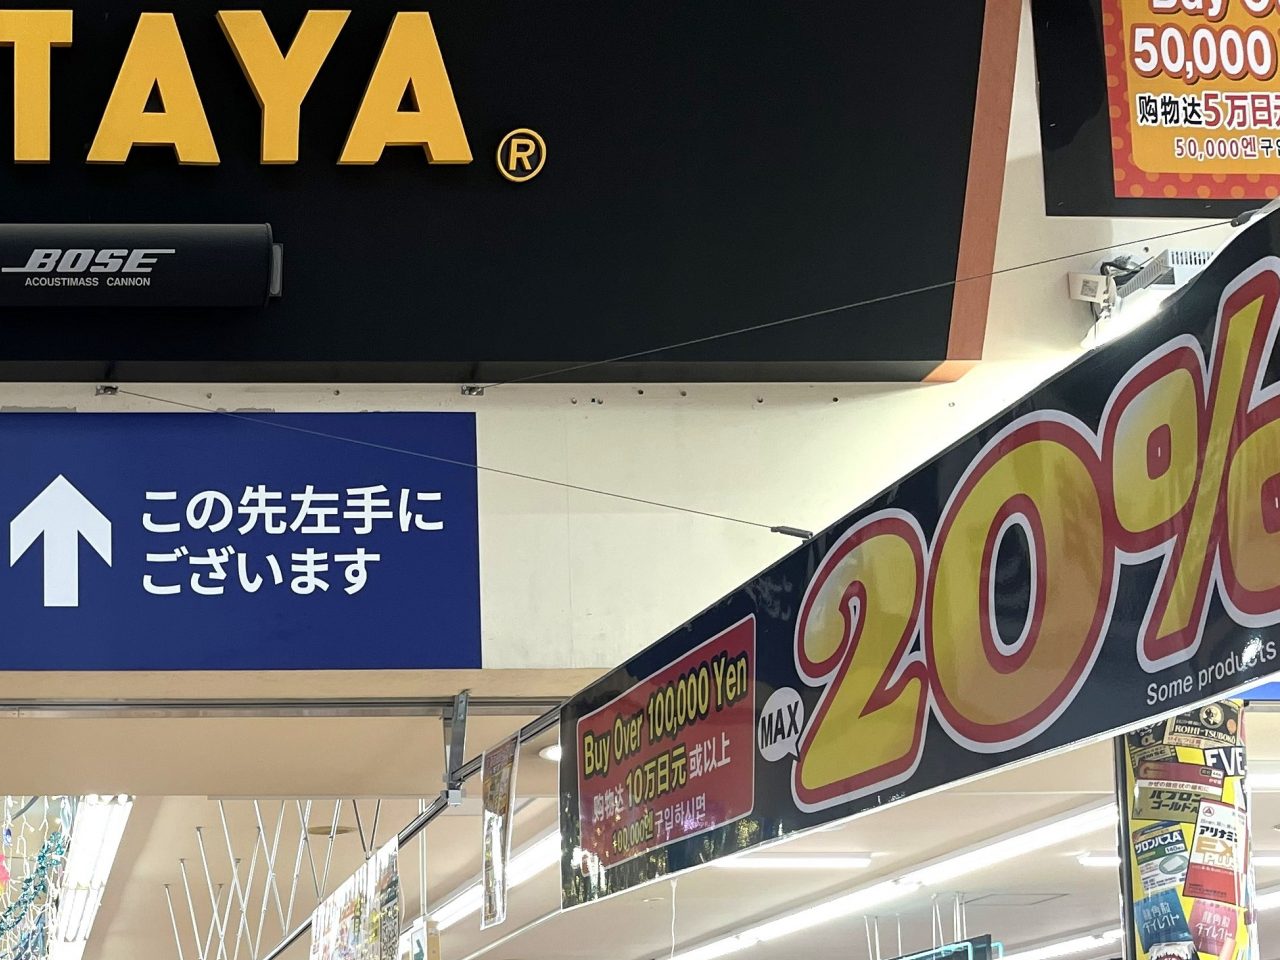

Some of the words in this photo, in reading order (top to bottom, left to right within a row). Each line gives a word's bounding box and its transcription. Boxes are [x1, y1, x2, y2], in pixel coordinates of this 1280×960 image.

[1134, 27, 1271, 79] 50,000
[1, 249, 175, 273] BOSE
[24, 276, 98, 287] ACOUSTIMASS
[106, 276, 150, 287] CANNON
[141, 488, 444, 536] この先左手に
[141, 548, 380, 598] ございます
[1146, 677, 1193, 706] Some
[584, 734, 610, 777] Buy
[613, 713, 644, 761] Over
[647, 667, 709, 740] 100,000
[713, 656, 747, 706] Yen
[761, 701, 799, 749] MAX
[1200, 826, 1238, 842] アリナミ
